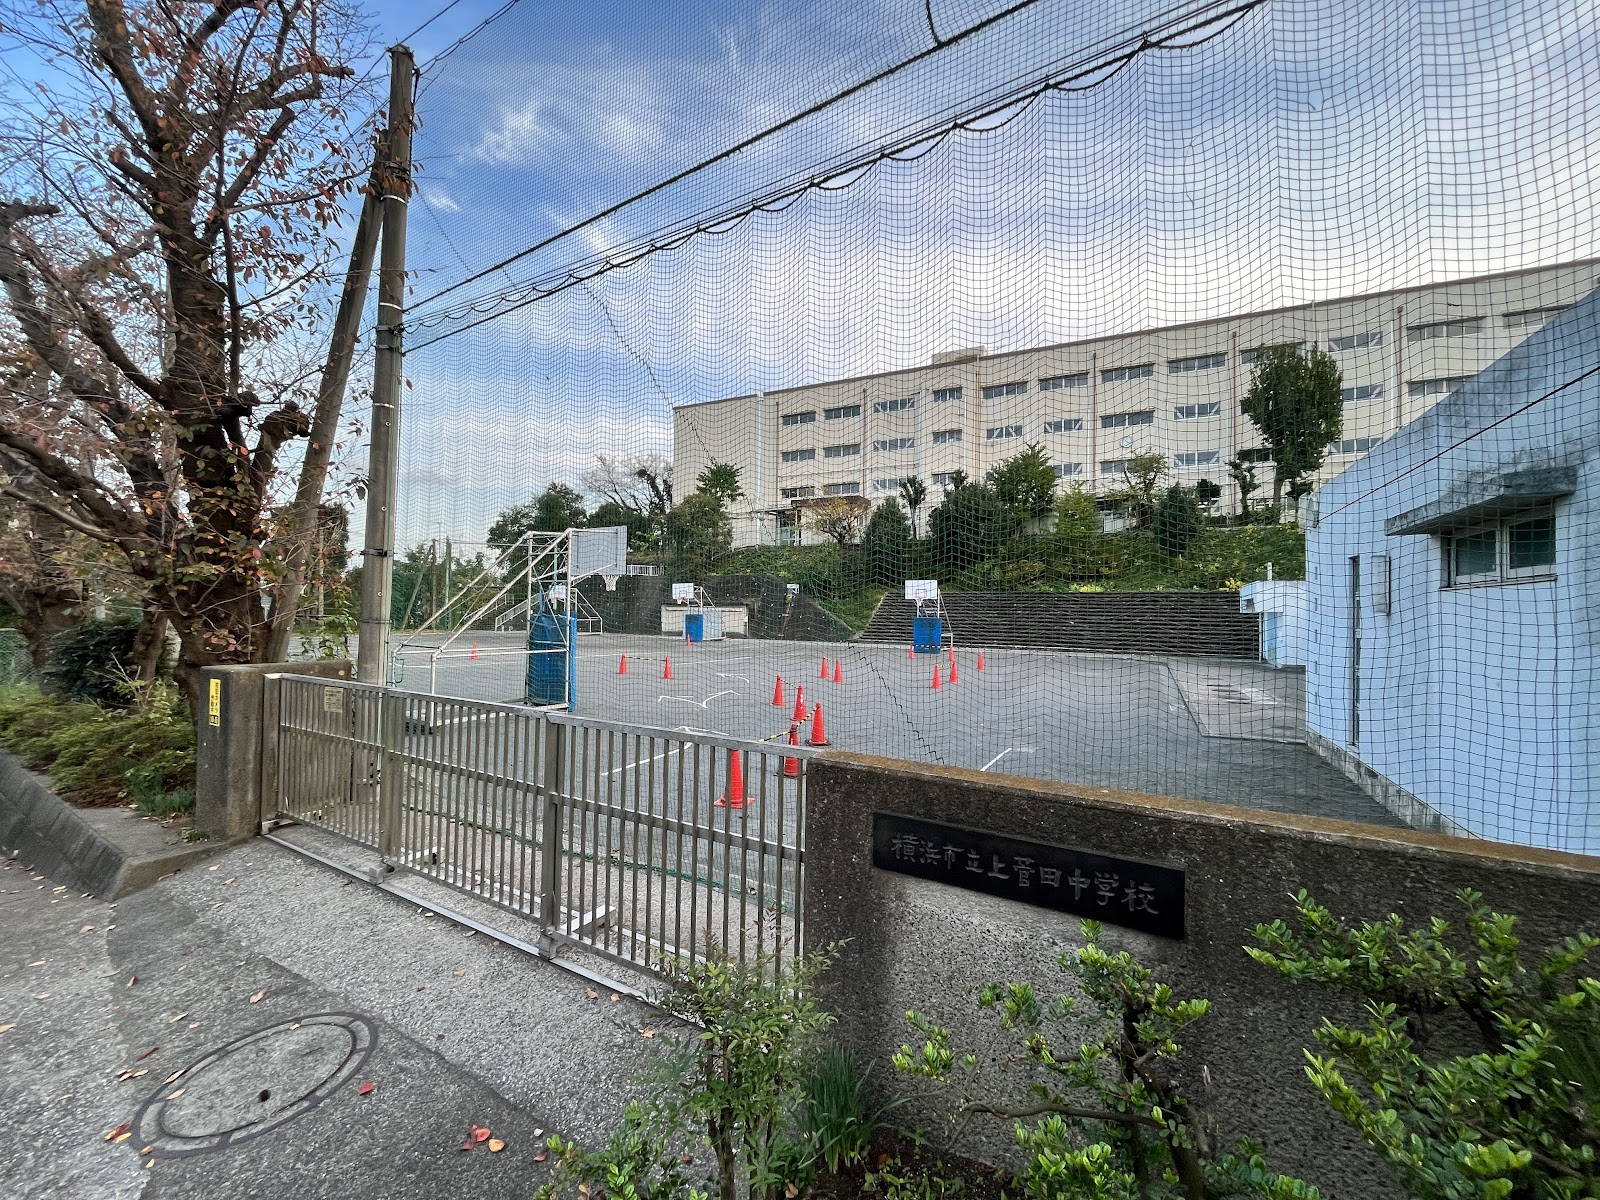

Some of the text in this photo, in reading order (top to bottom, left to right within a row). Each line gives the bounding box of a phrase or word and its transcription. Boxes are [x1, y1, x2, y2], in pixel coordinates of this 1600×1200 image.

[890, 833, 1159, 914] 横浜市立上菅田中学校
